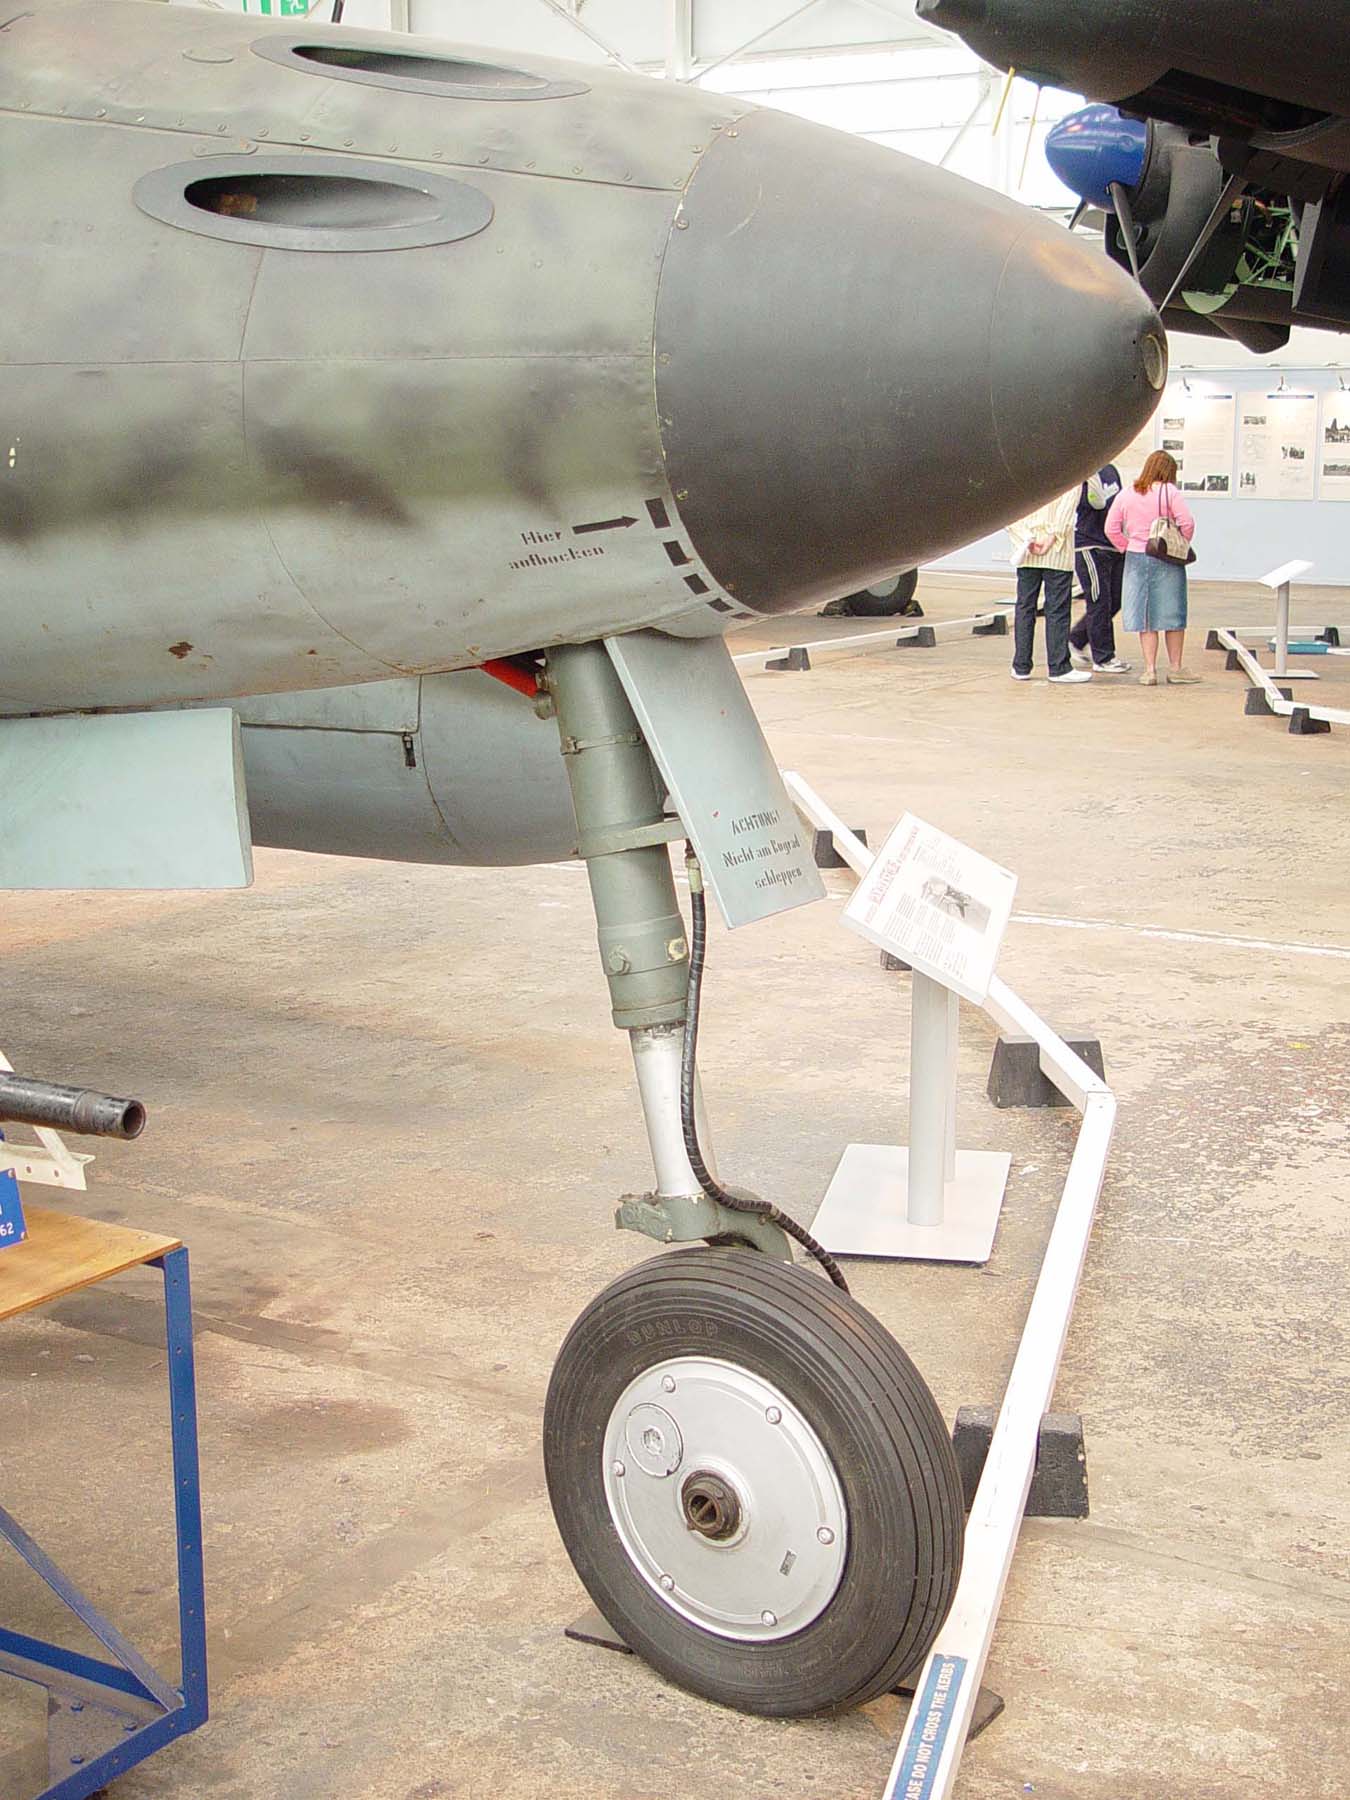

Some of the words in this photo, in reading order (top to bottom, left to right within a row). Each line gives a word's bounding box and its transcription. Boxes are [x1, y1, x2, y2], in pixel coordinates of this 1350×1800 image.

[520, 531, 562, 545] Hier
[722, 846, 755, 868] Nicht
[755, 846, 772, 859] am
[754, 867, 803, 889] schleppen
[626, 1318, 719, 1347] DUNLOP
[935, 1662, 956, 1692] KERBS
[930, 1691, 950, 1710] THE
[921, 1710, 944, 1741] CROSS
[917, 1740, 934, 1762] NOT
[911, 1762, 929, 1780] DO
[903, 1779, 923, 1800] ASE
